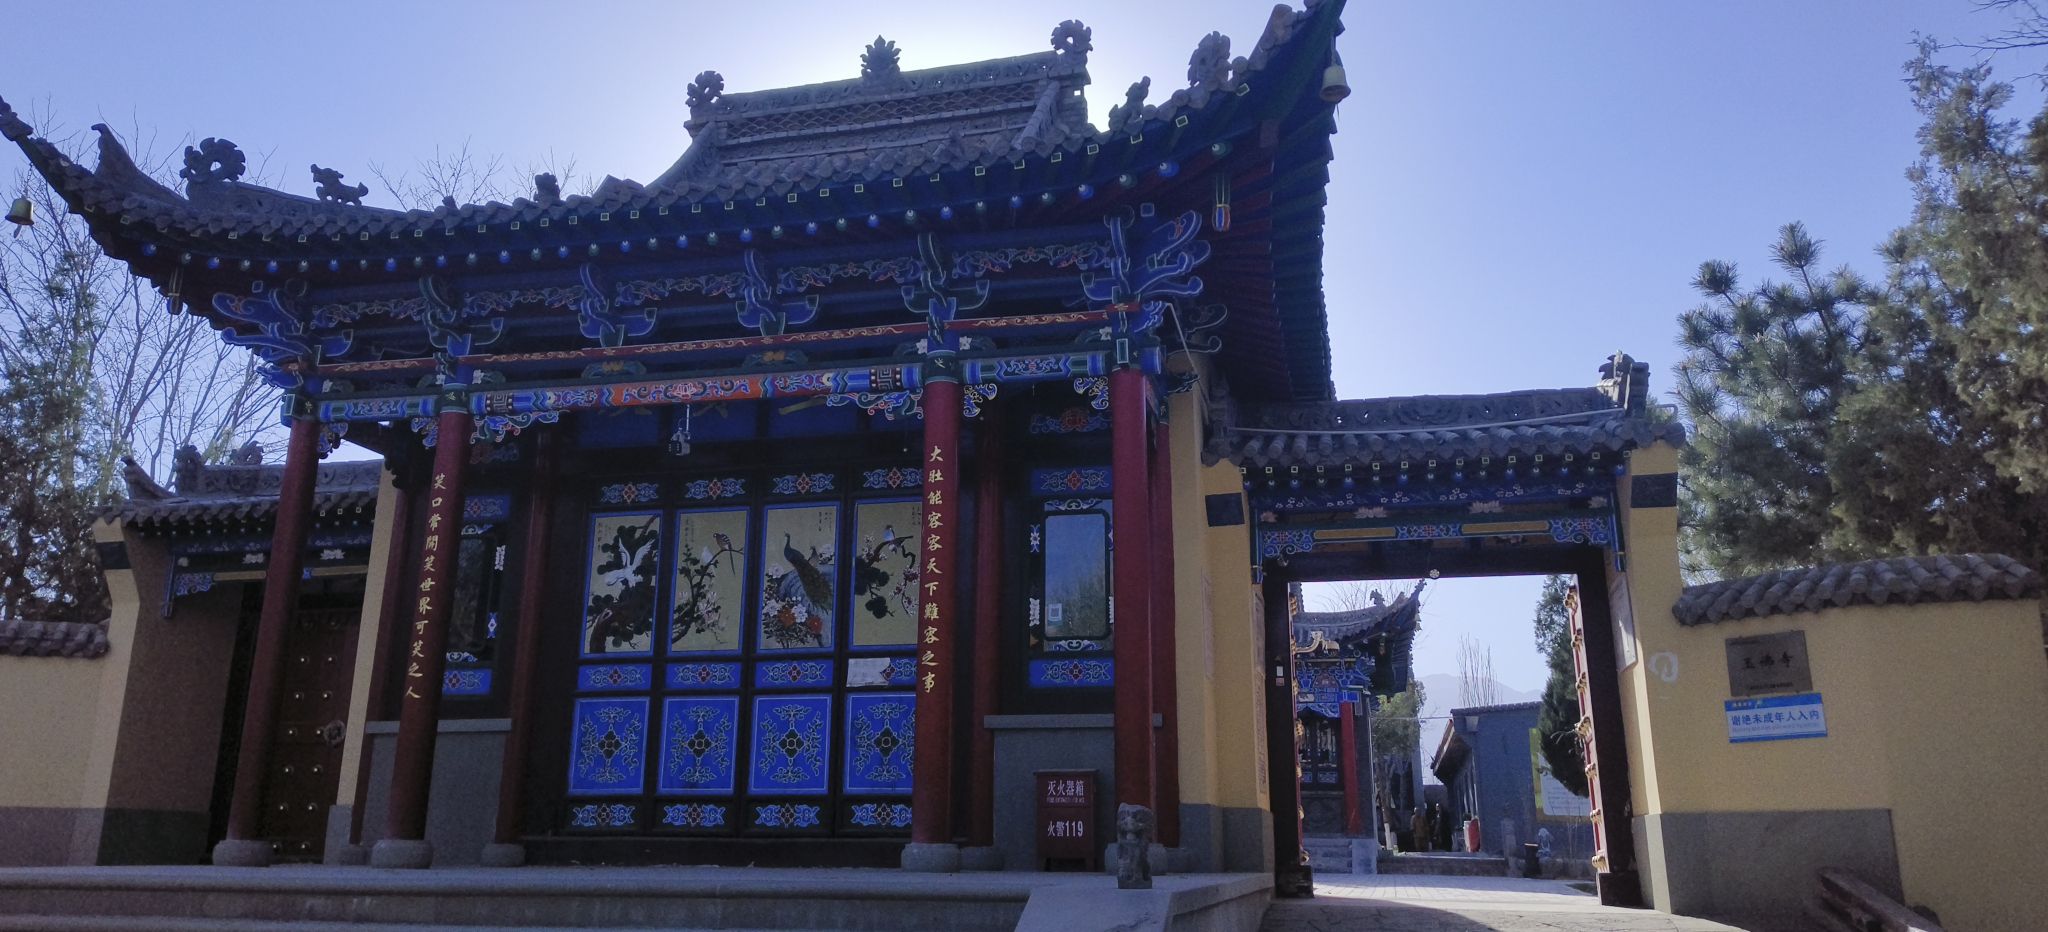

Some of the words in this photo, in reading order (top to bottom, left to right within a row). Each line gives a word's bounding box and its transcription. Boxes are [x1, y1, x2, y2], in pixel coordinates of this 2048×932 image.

[1731, 710, 1820, 726] 谢绝未成年人入内
[1047, 779, 1084, 796] 灭火器箱
